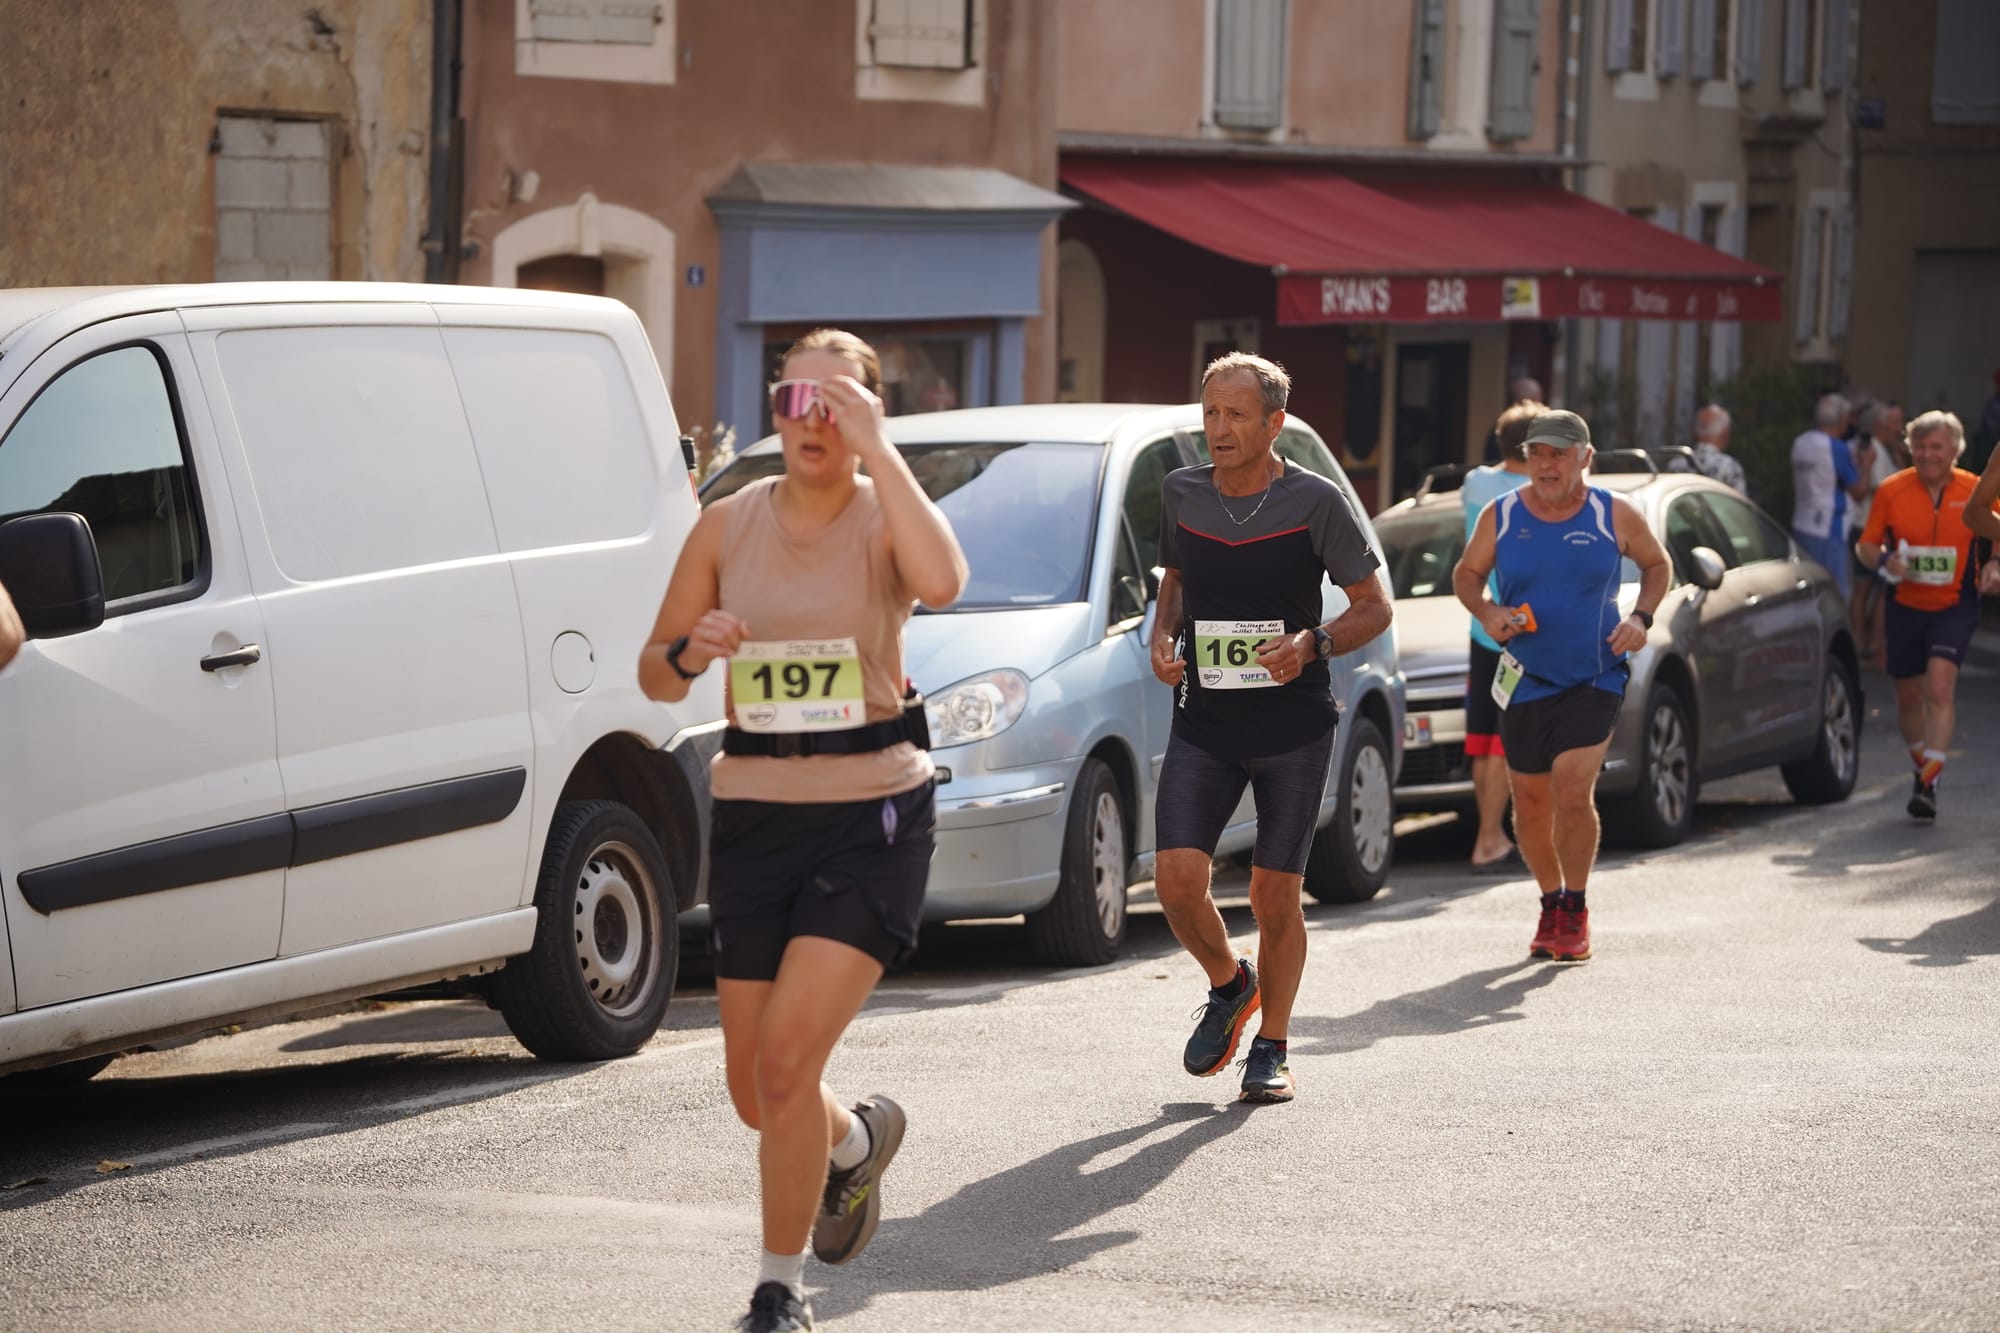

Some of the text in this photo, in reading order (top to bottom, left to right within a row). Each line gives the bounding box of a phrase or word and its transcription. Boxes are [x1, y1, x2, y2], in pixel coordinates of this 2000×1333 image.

[1321, 277, 1391, 315] RYAN'S
[1426, 279, 1467, 315] BAR
[752, 662, 841, 699] 197
